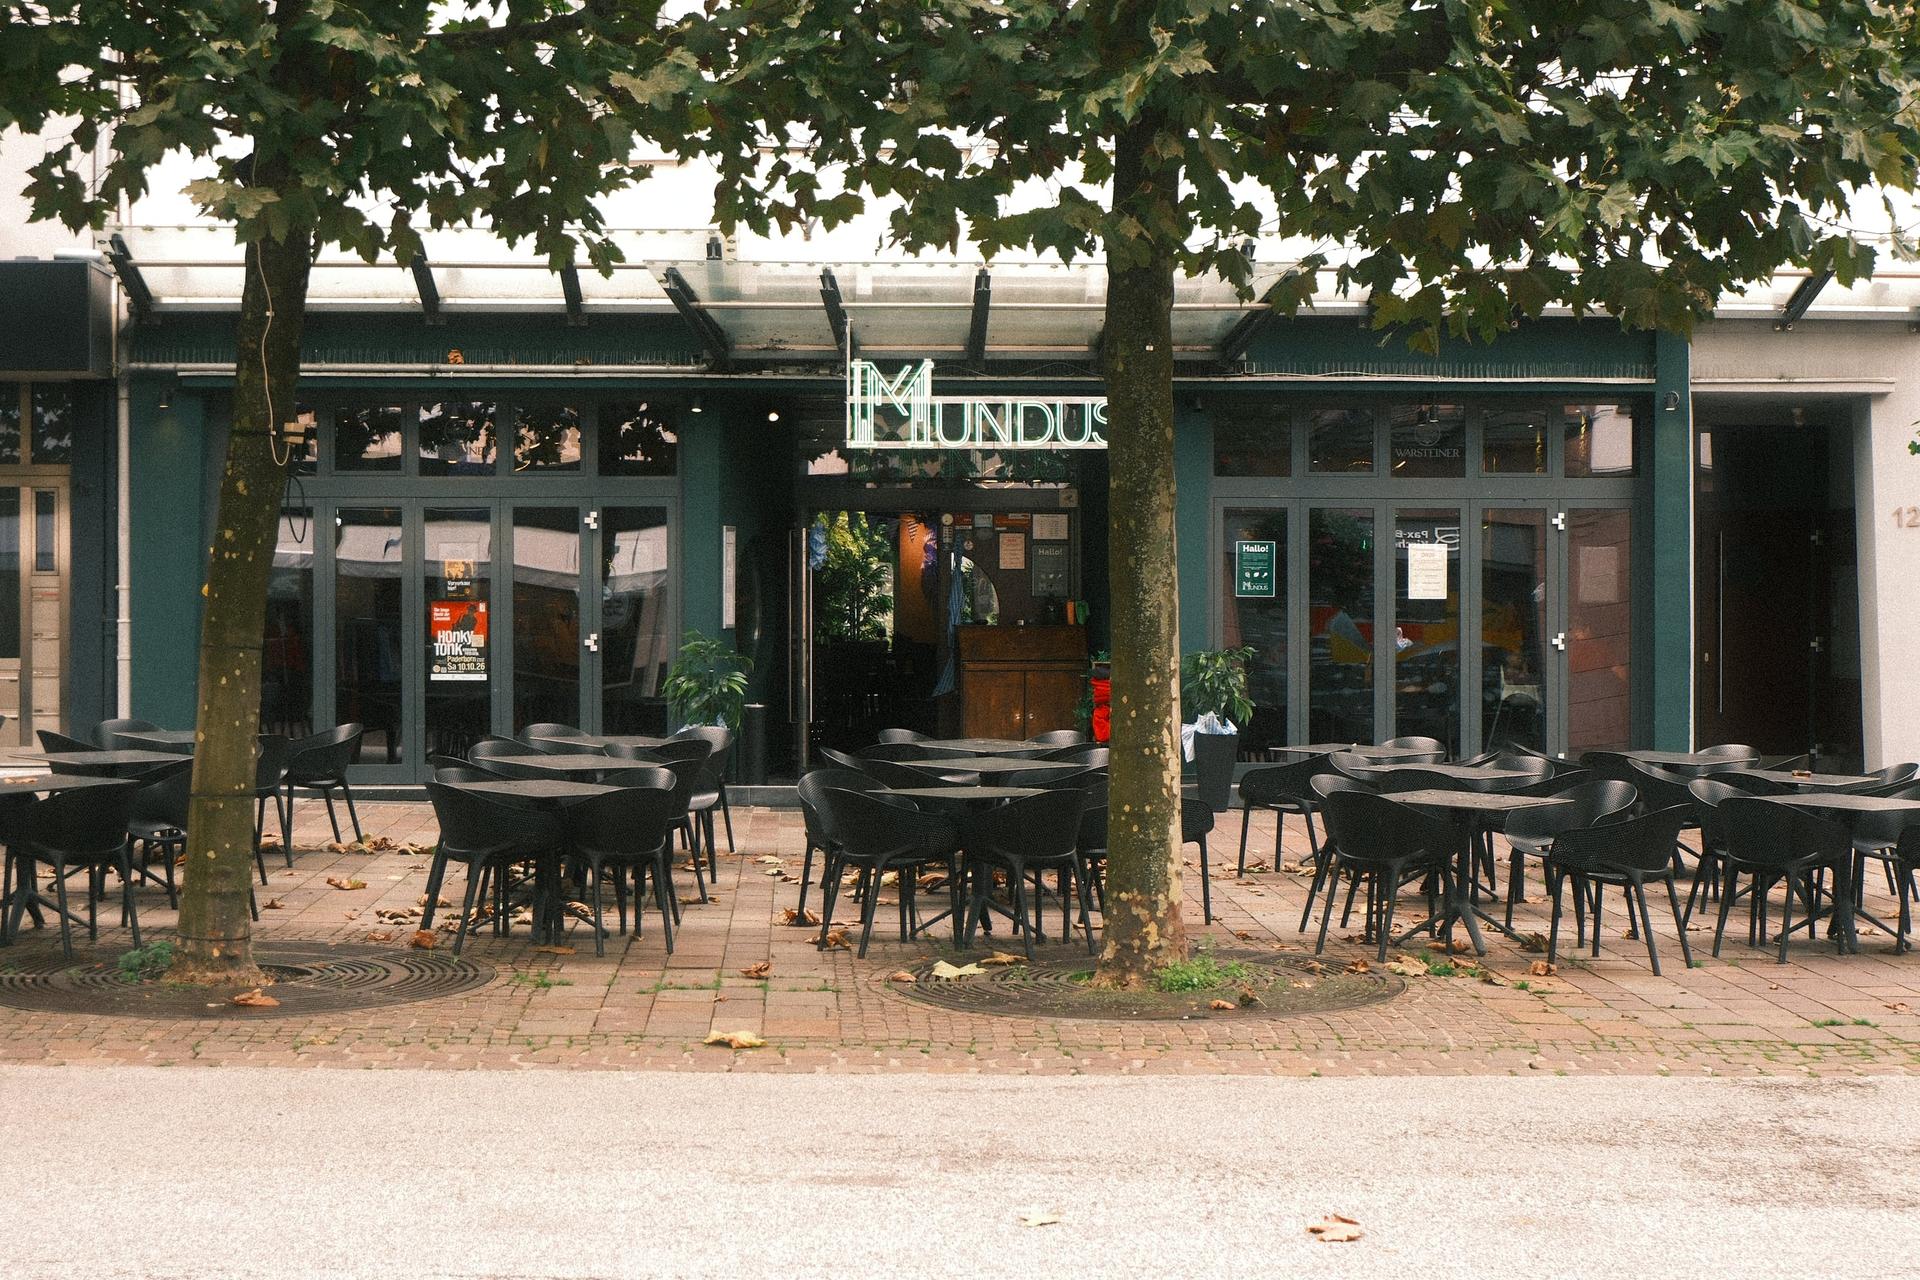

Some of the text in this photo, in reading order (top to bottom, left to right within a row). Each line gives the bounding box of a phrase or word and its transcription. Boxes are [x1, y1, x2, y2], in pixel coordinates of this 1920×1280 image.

[1395, 448, 1460, 458] WARSTEINER
[1891, 506, 1920, 528] 12
[1038, 548, 1063, 556] Hallo!
[1242, 544, 1269, 553] Hallo!
[1242, 581, 1269, 591] MUNDUS
[447, 663, 486, 671] Sa 10.10.26
